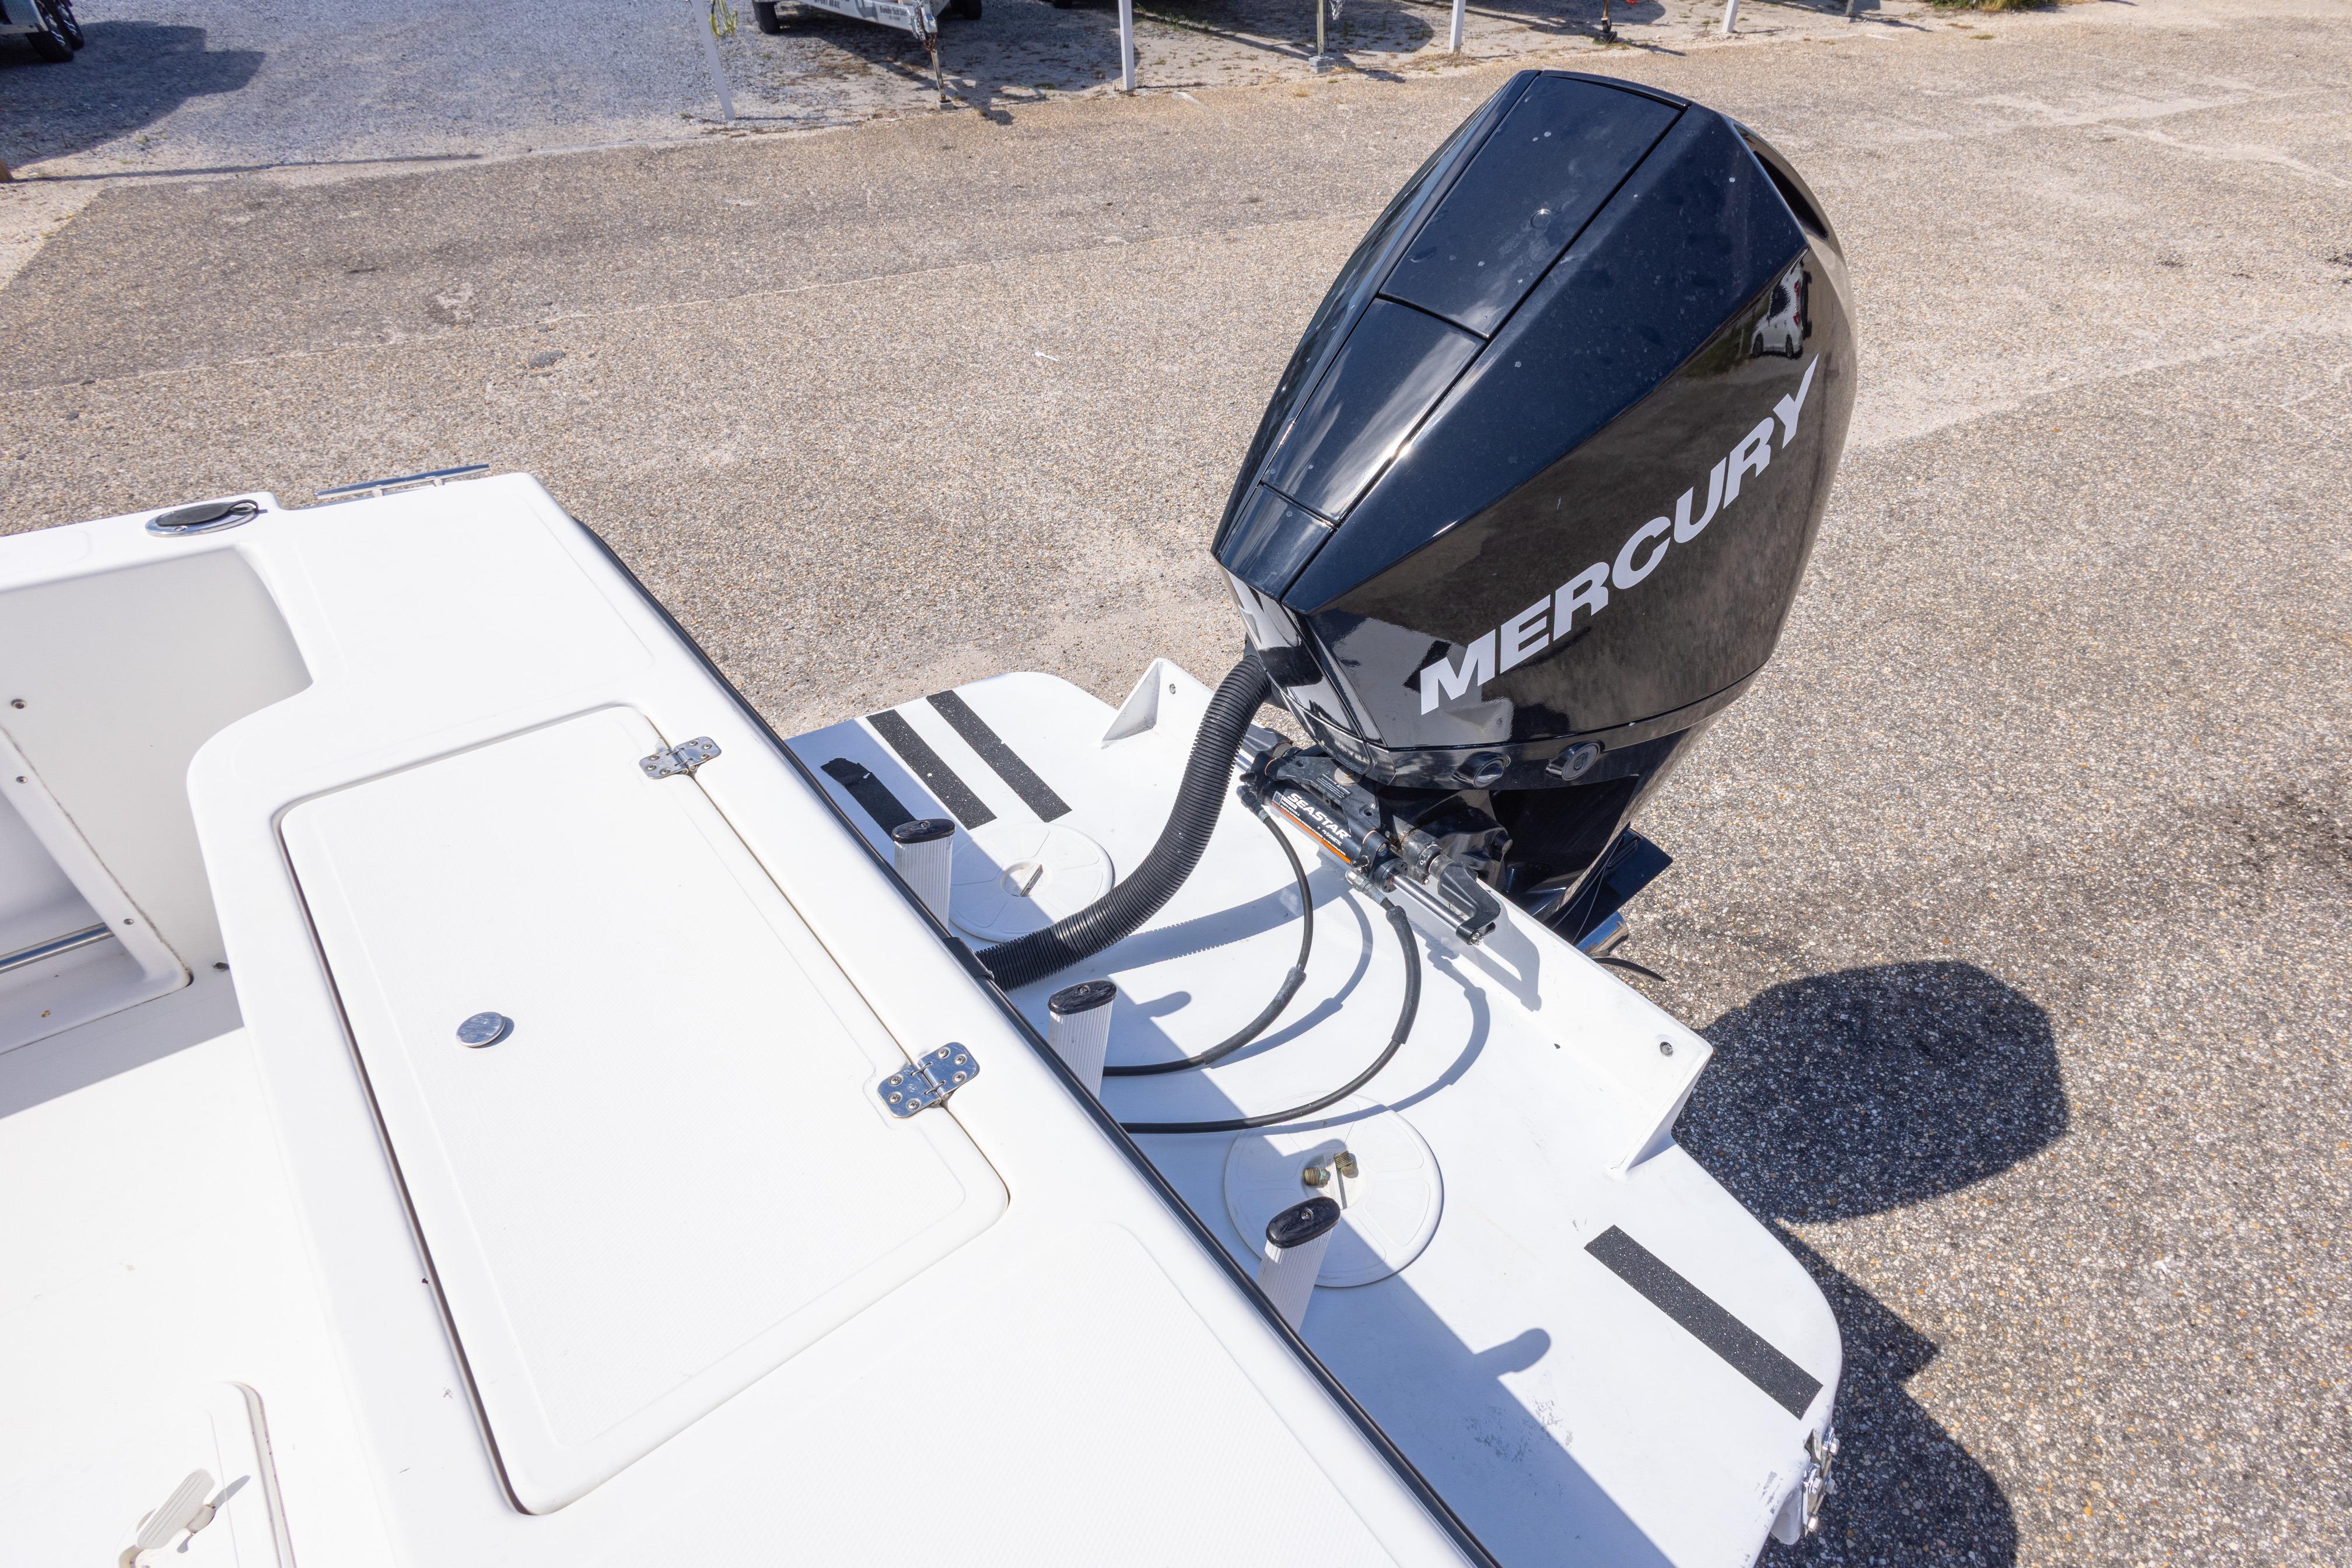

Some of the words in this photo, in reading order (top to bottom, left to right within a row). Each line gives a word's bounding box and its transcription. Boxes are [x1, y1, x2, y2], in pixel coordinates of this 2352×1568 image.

[1420, 354, 1819, 716] MERCURY
[1287, 793, 1349, 839] SEASTAR
[1326, 832, 1342, 846] DOMETIC
